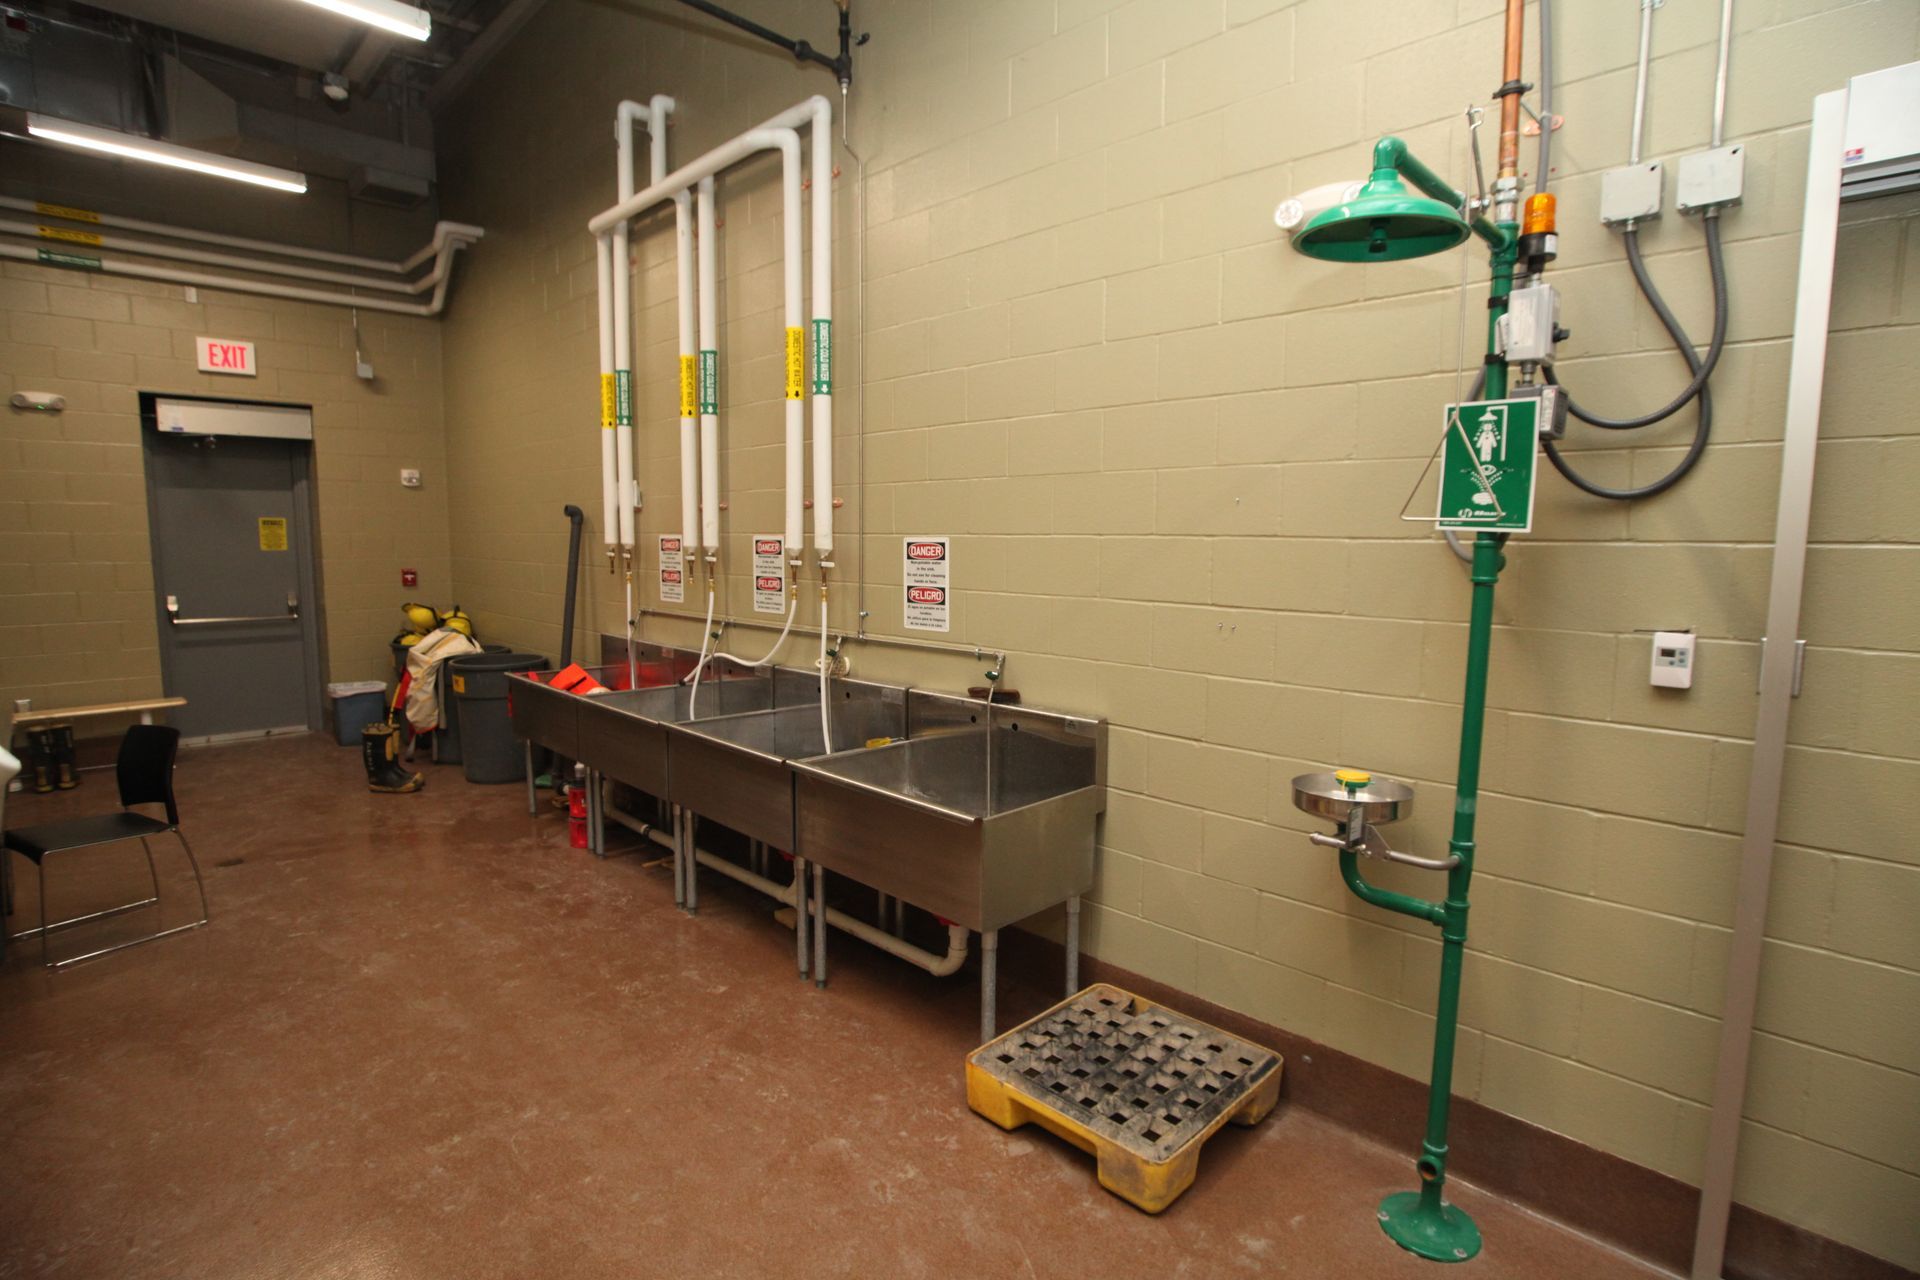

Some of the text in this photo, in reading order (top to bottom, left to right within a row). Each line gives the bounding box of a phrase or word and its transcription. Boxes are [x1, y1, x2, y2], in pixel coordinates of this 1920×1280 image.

[208, 343, 247, 369] EXIT
[758, 543, 779, 552] DANGER
[910, 546, 941, 556] DANGER
[758, 579, 780, 589] PELIGRO
[910, 590, 941, 601] PELIGRO
